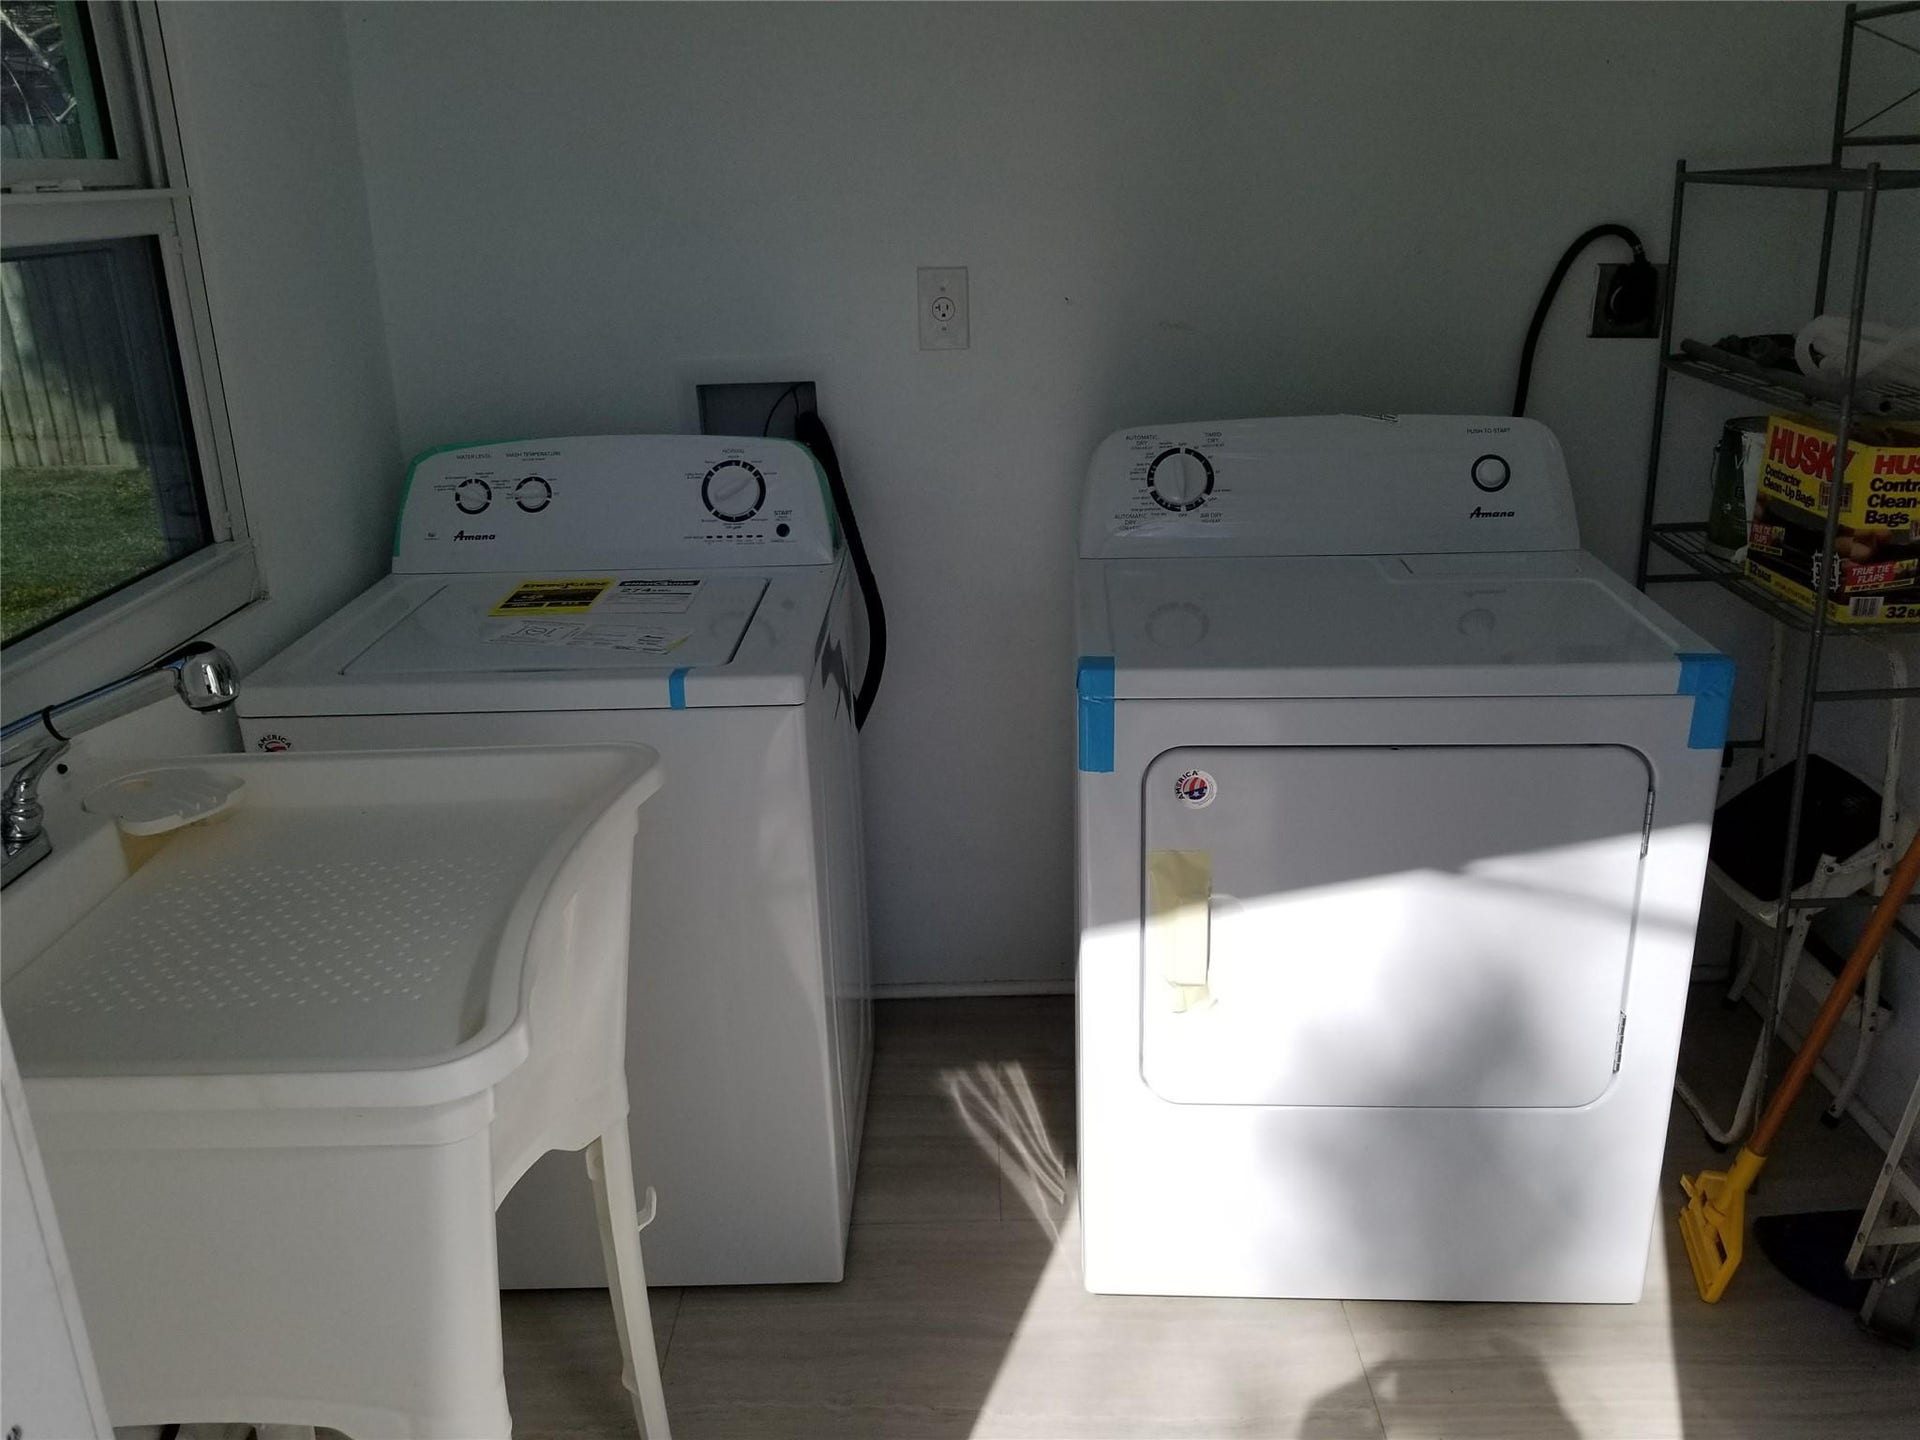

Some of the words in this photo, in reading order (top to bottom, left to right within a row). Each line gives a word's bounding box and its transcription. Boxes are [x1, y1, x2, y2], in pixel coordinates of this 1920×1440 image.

[1469, 506, 1515, 519] Amana
[1864, 510, 1910, 527] Bags
[453, 530, 496, 542] Amana
[1852, 566, 1875, 577] TRUE
[1856, 573, 1885, 585] FLAPS
[1886, 606, 1907, 618] 32
[258, 734, 292, 750] AMERICA
[1174, 769, 1199, 800] AMERICA
